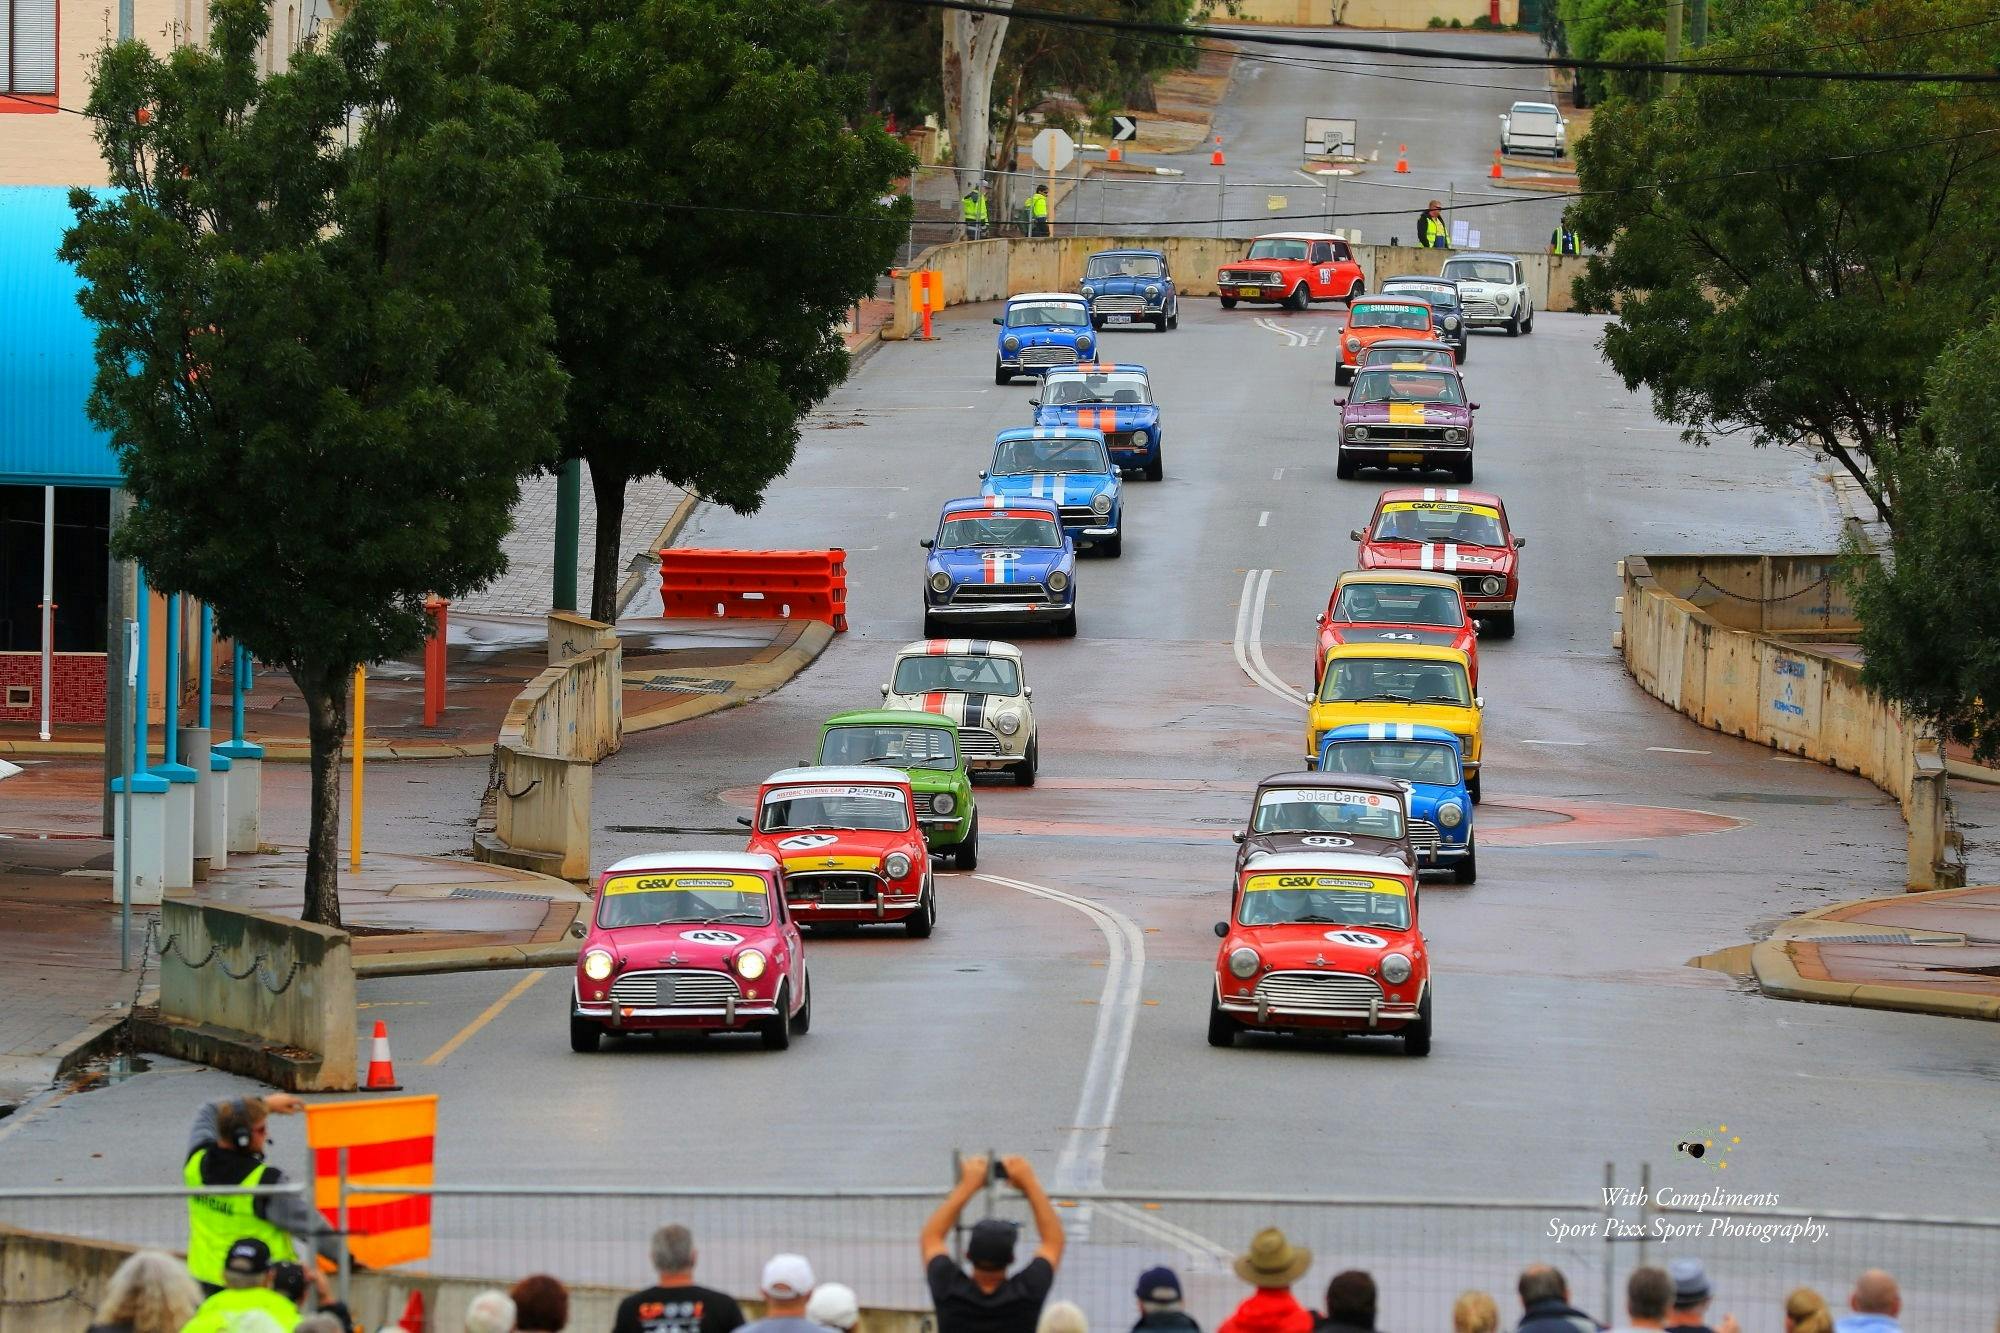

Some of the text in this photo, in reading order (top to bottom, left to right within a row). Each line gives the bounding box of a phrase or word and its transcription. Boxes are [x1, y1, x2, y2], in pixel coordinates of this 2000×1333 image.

[1370, 304, 1410, 313] SHANNONS
[1297, 790, 1366, 804] SolarCare
[1309, 838, 1348, 846] 99
[636, 878, 674, 890] G&V
[677, 879, 731, 888] earthmoving
[1278, 876, 1316, 888] G&V
[1318, 878, 1373, 888] earthmoving
[693, 932, 738, 942] 49
[1334, 933, 1378, 944] 16
